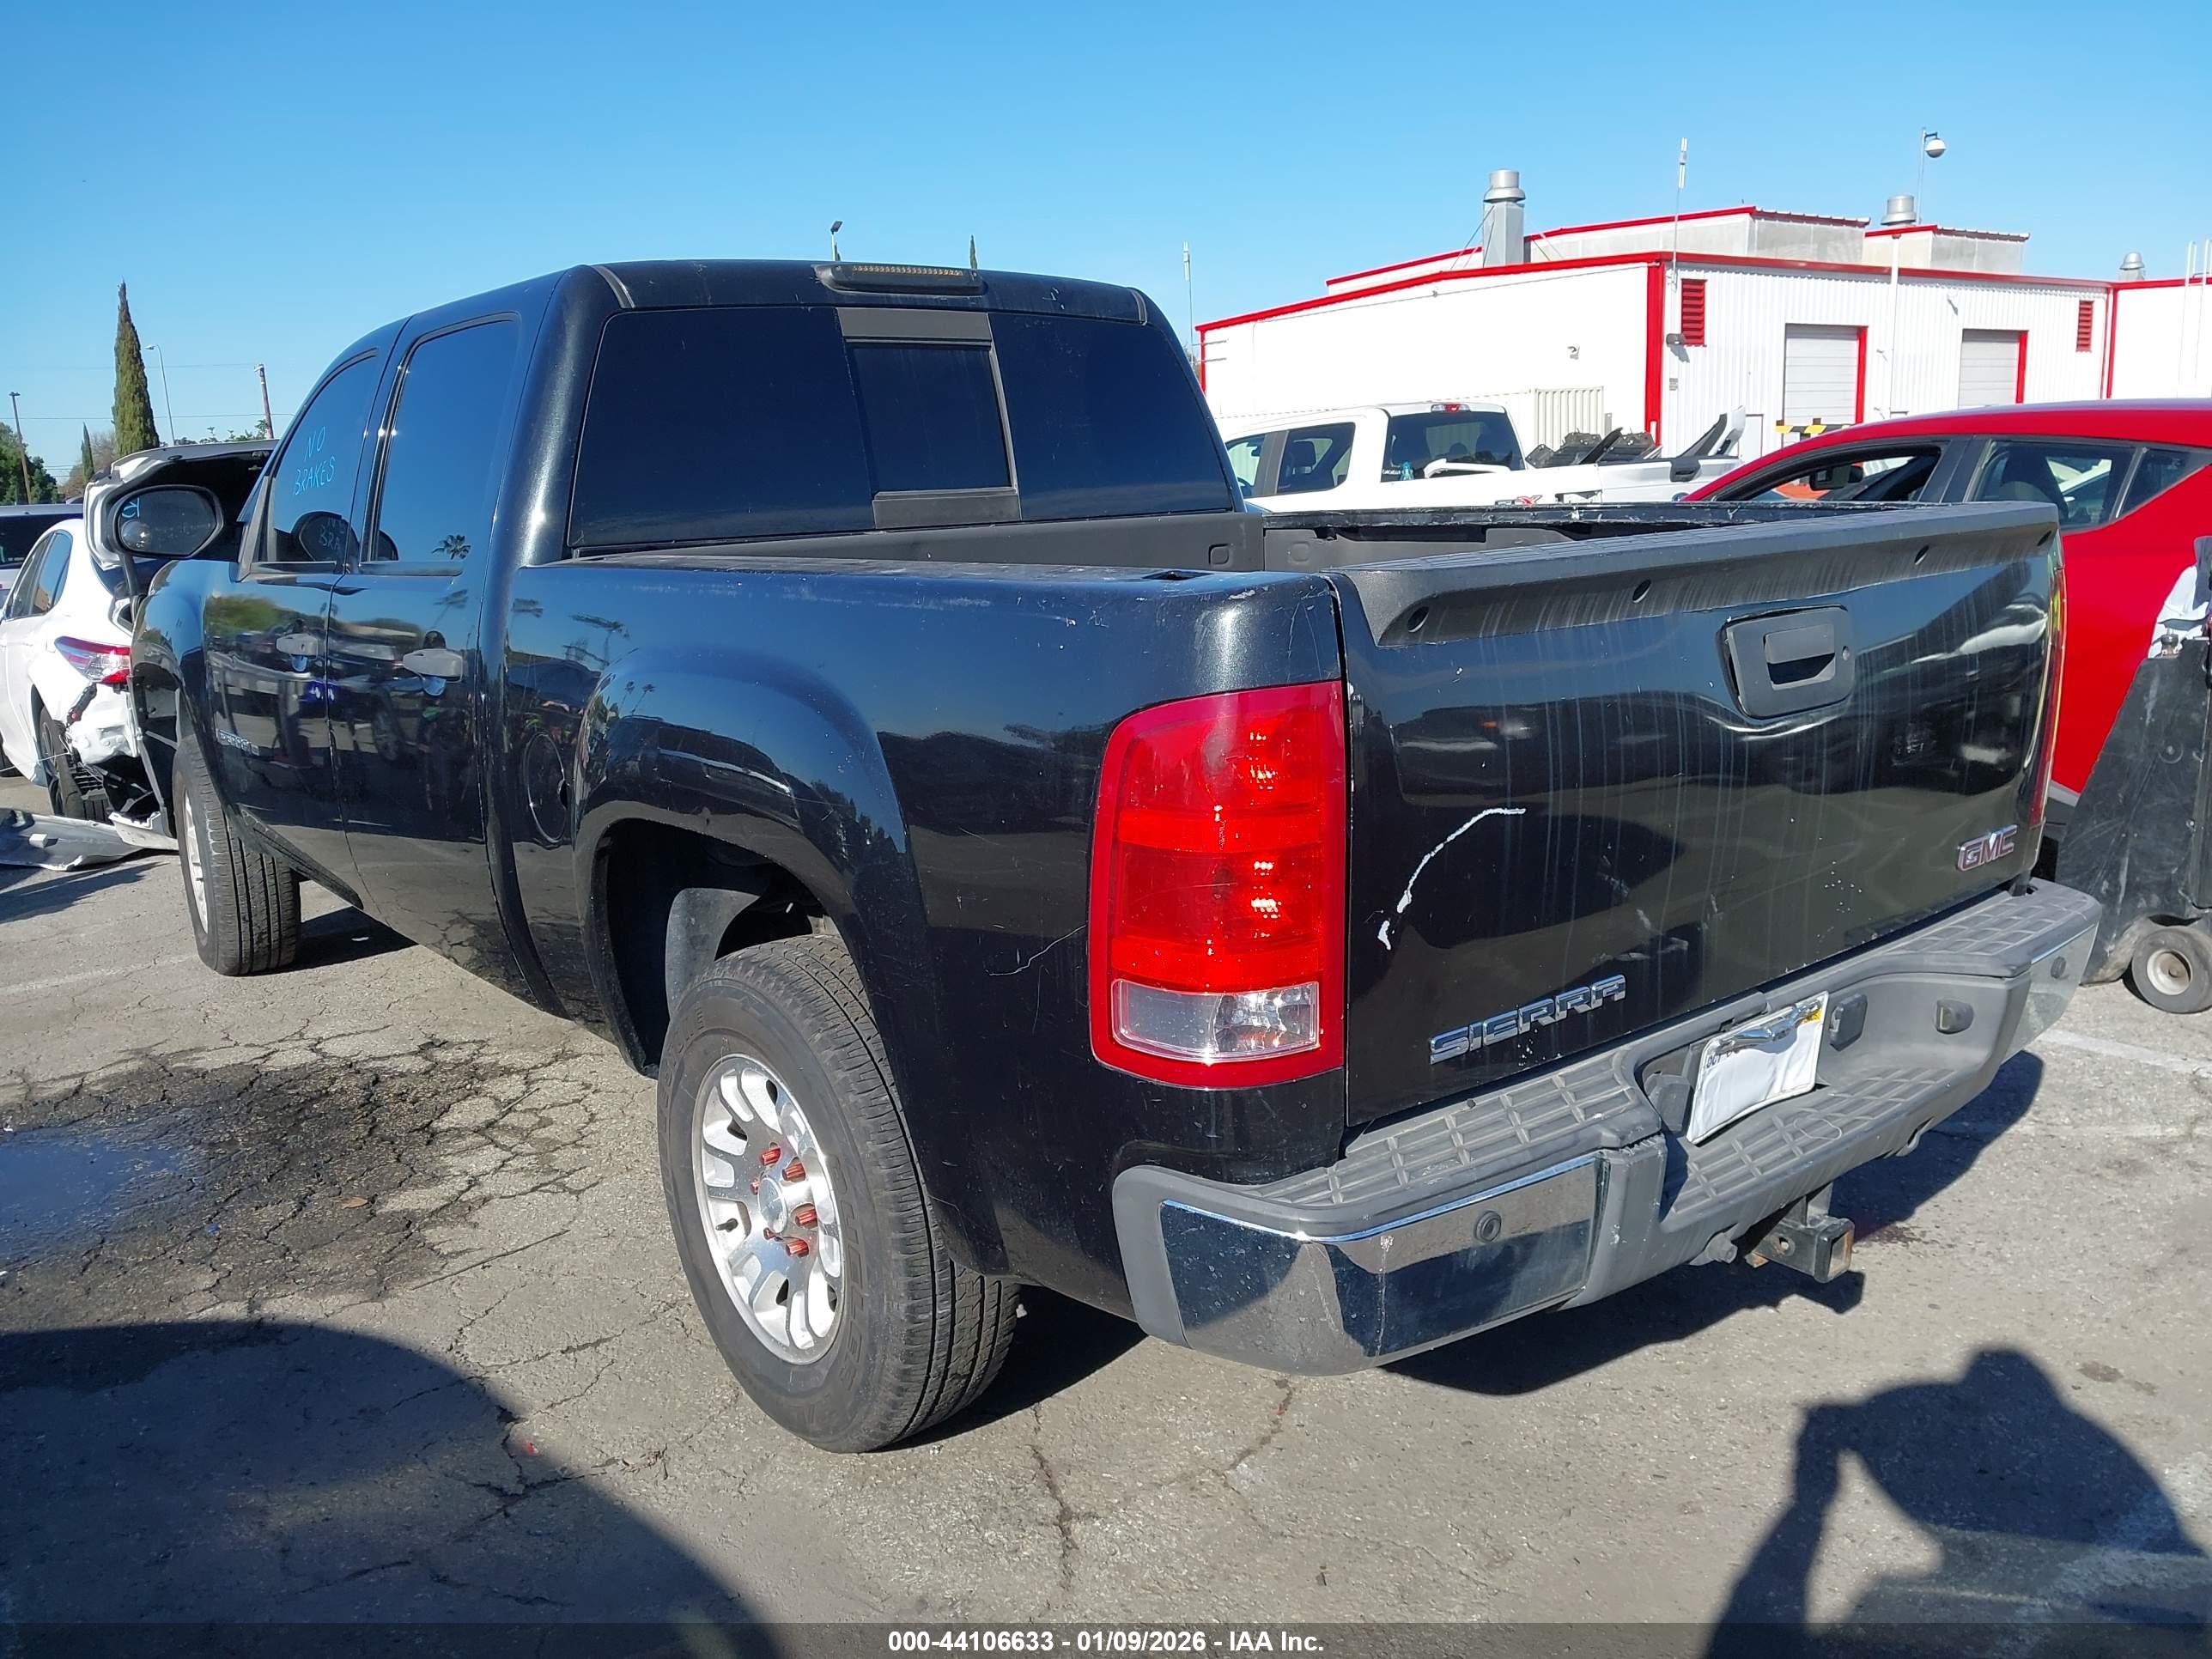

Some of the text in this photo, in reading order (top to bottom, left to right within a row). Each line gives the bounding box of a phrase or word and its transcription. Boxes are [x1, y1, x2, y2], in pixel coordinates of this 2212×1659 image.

[304, 425, 327, 461] NO
[293, 455, 336, 496] BRAKES
[1957, 824, 2018, 872] GMC
[1430, 974, 1626, 1065] SIERRA
